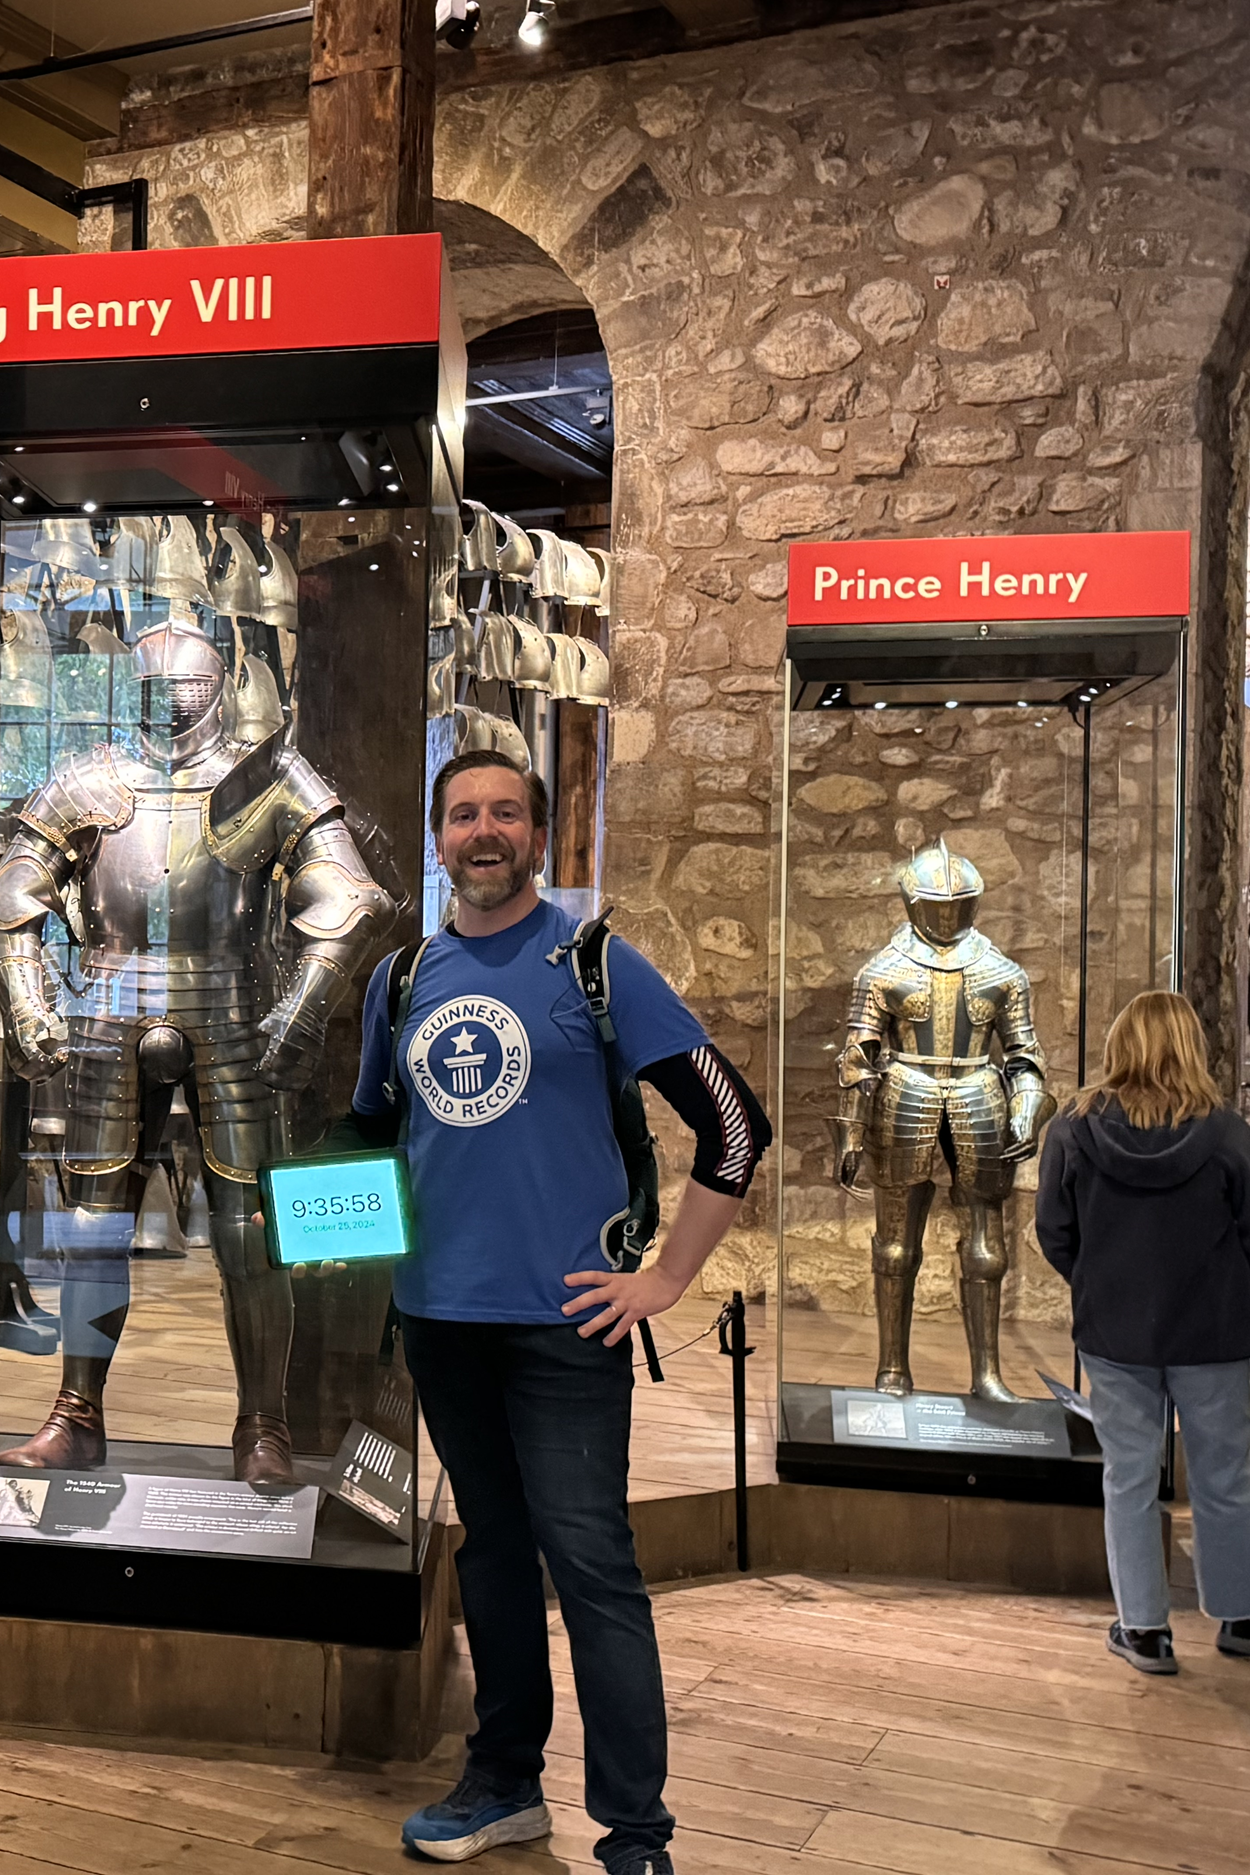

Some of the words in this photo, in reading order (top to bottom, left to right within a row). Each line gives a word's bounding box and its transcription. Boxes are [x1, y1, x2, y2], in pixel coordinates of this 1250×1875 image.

[28, 286, 172, 337] Henry
[190, 275, 272, 323] VIII
[814, 566, 942, 601] Prince
[959, 561, 1088, 603] Henry
[421, 1003, 510, 1041] GUINNESS
[413, 1057, 454, 1114] WORLD
[462, 1045, 521, 1118] RECORDS
[292, 1192, 382, 1218] 9:35:58
[303, 1224, 337, 1234] October
